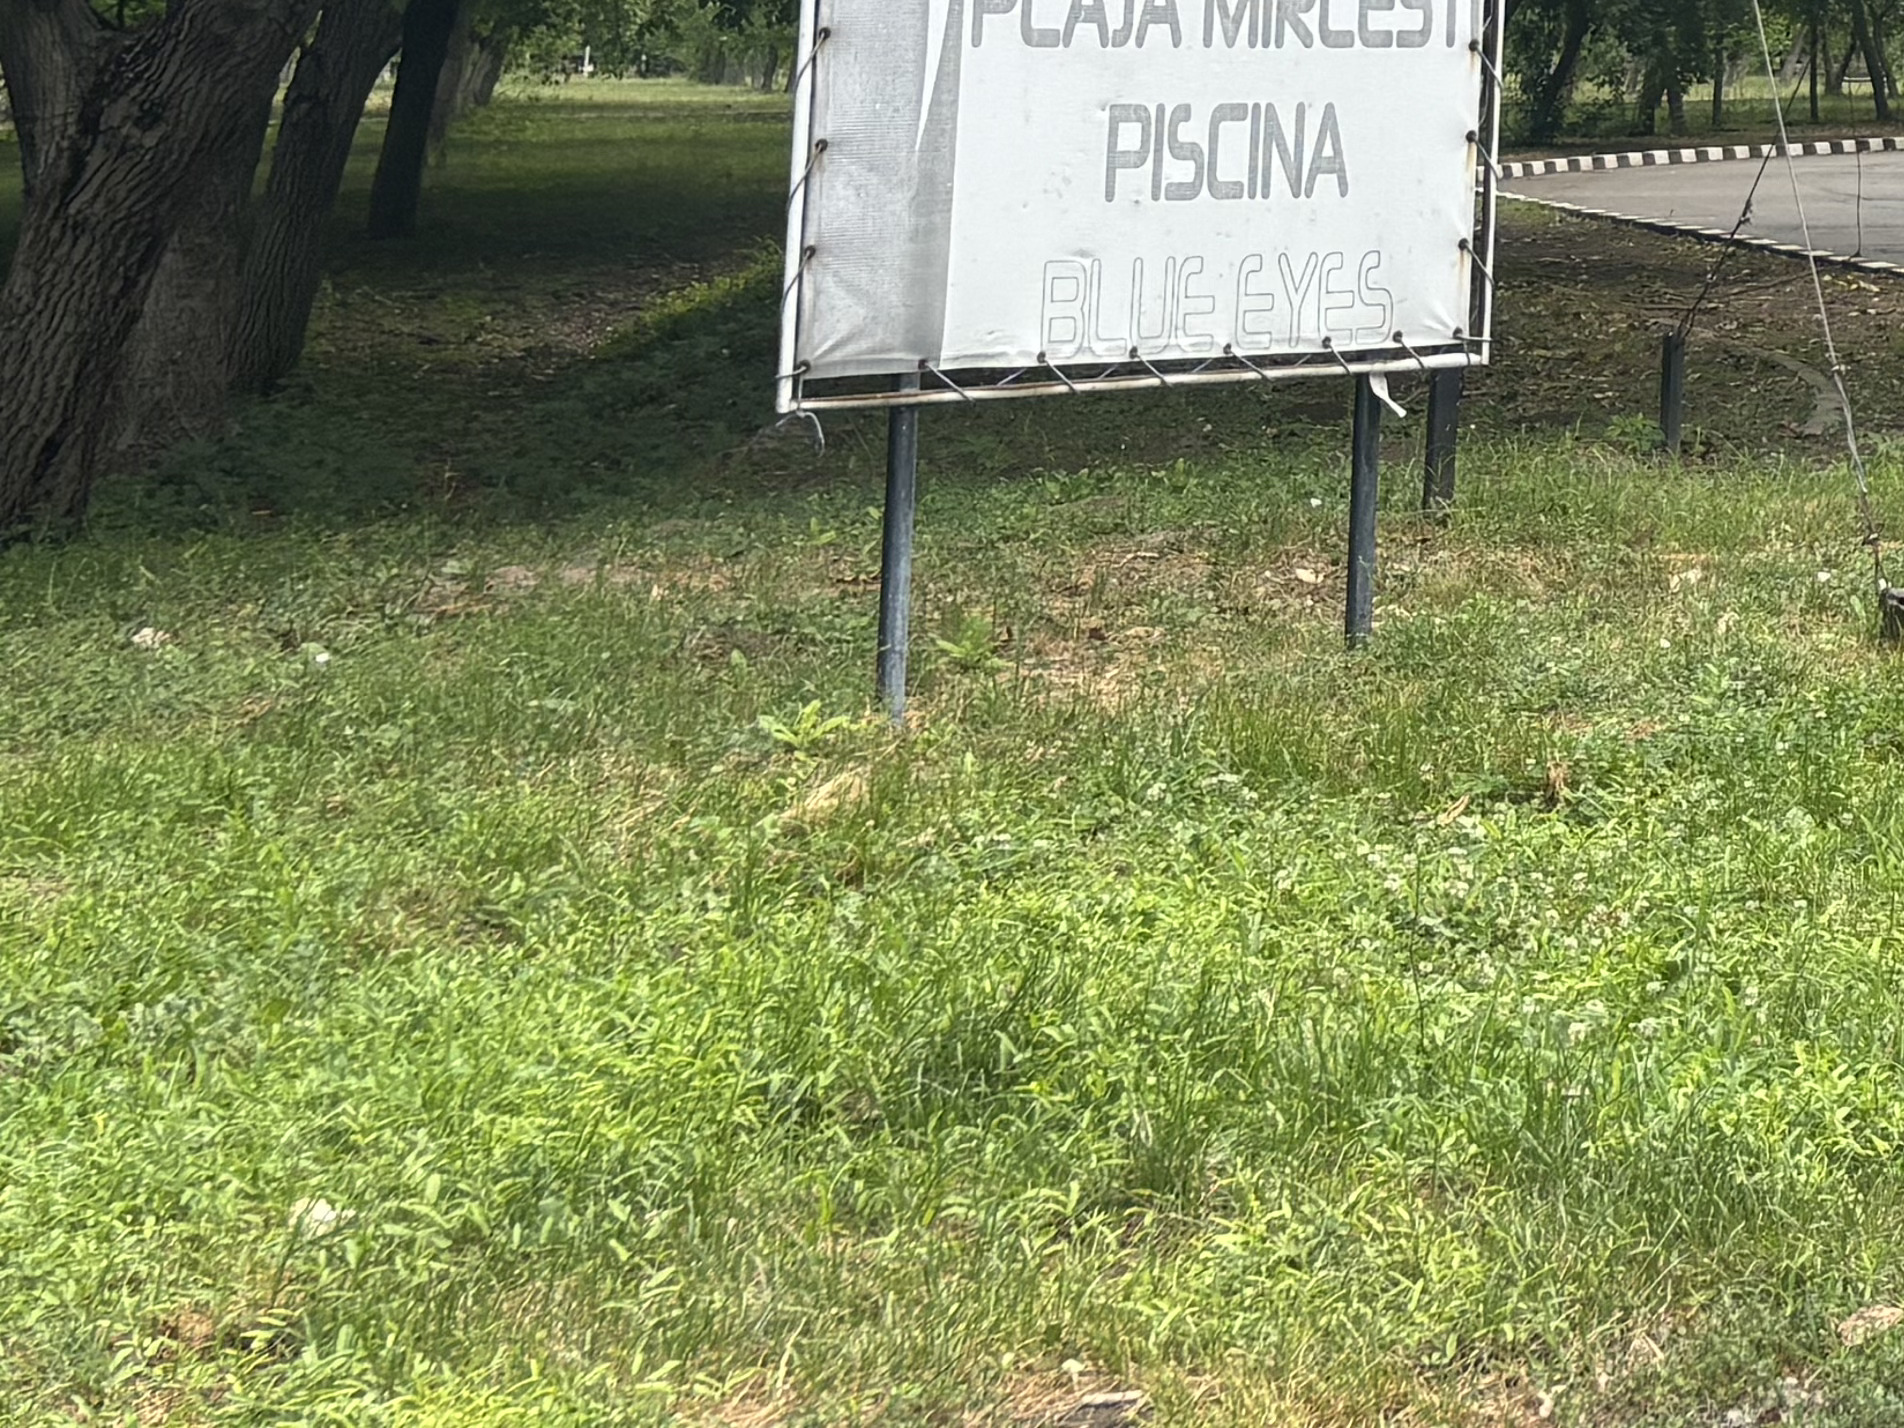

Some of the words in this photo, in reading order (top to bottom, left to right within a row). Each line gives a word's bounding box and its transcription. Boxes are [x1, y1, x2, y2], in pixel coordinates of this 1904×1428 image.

[1105, 101, 1349, 202] PISCINA
[1040, 255, 1216, 359] BLUE
[1235, 250, 1394, 350] EYES
